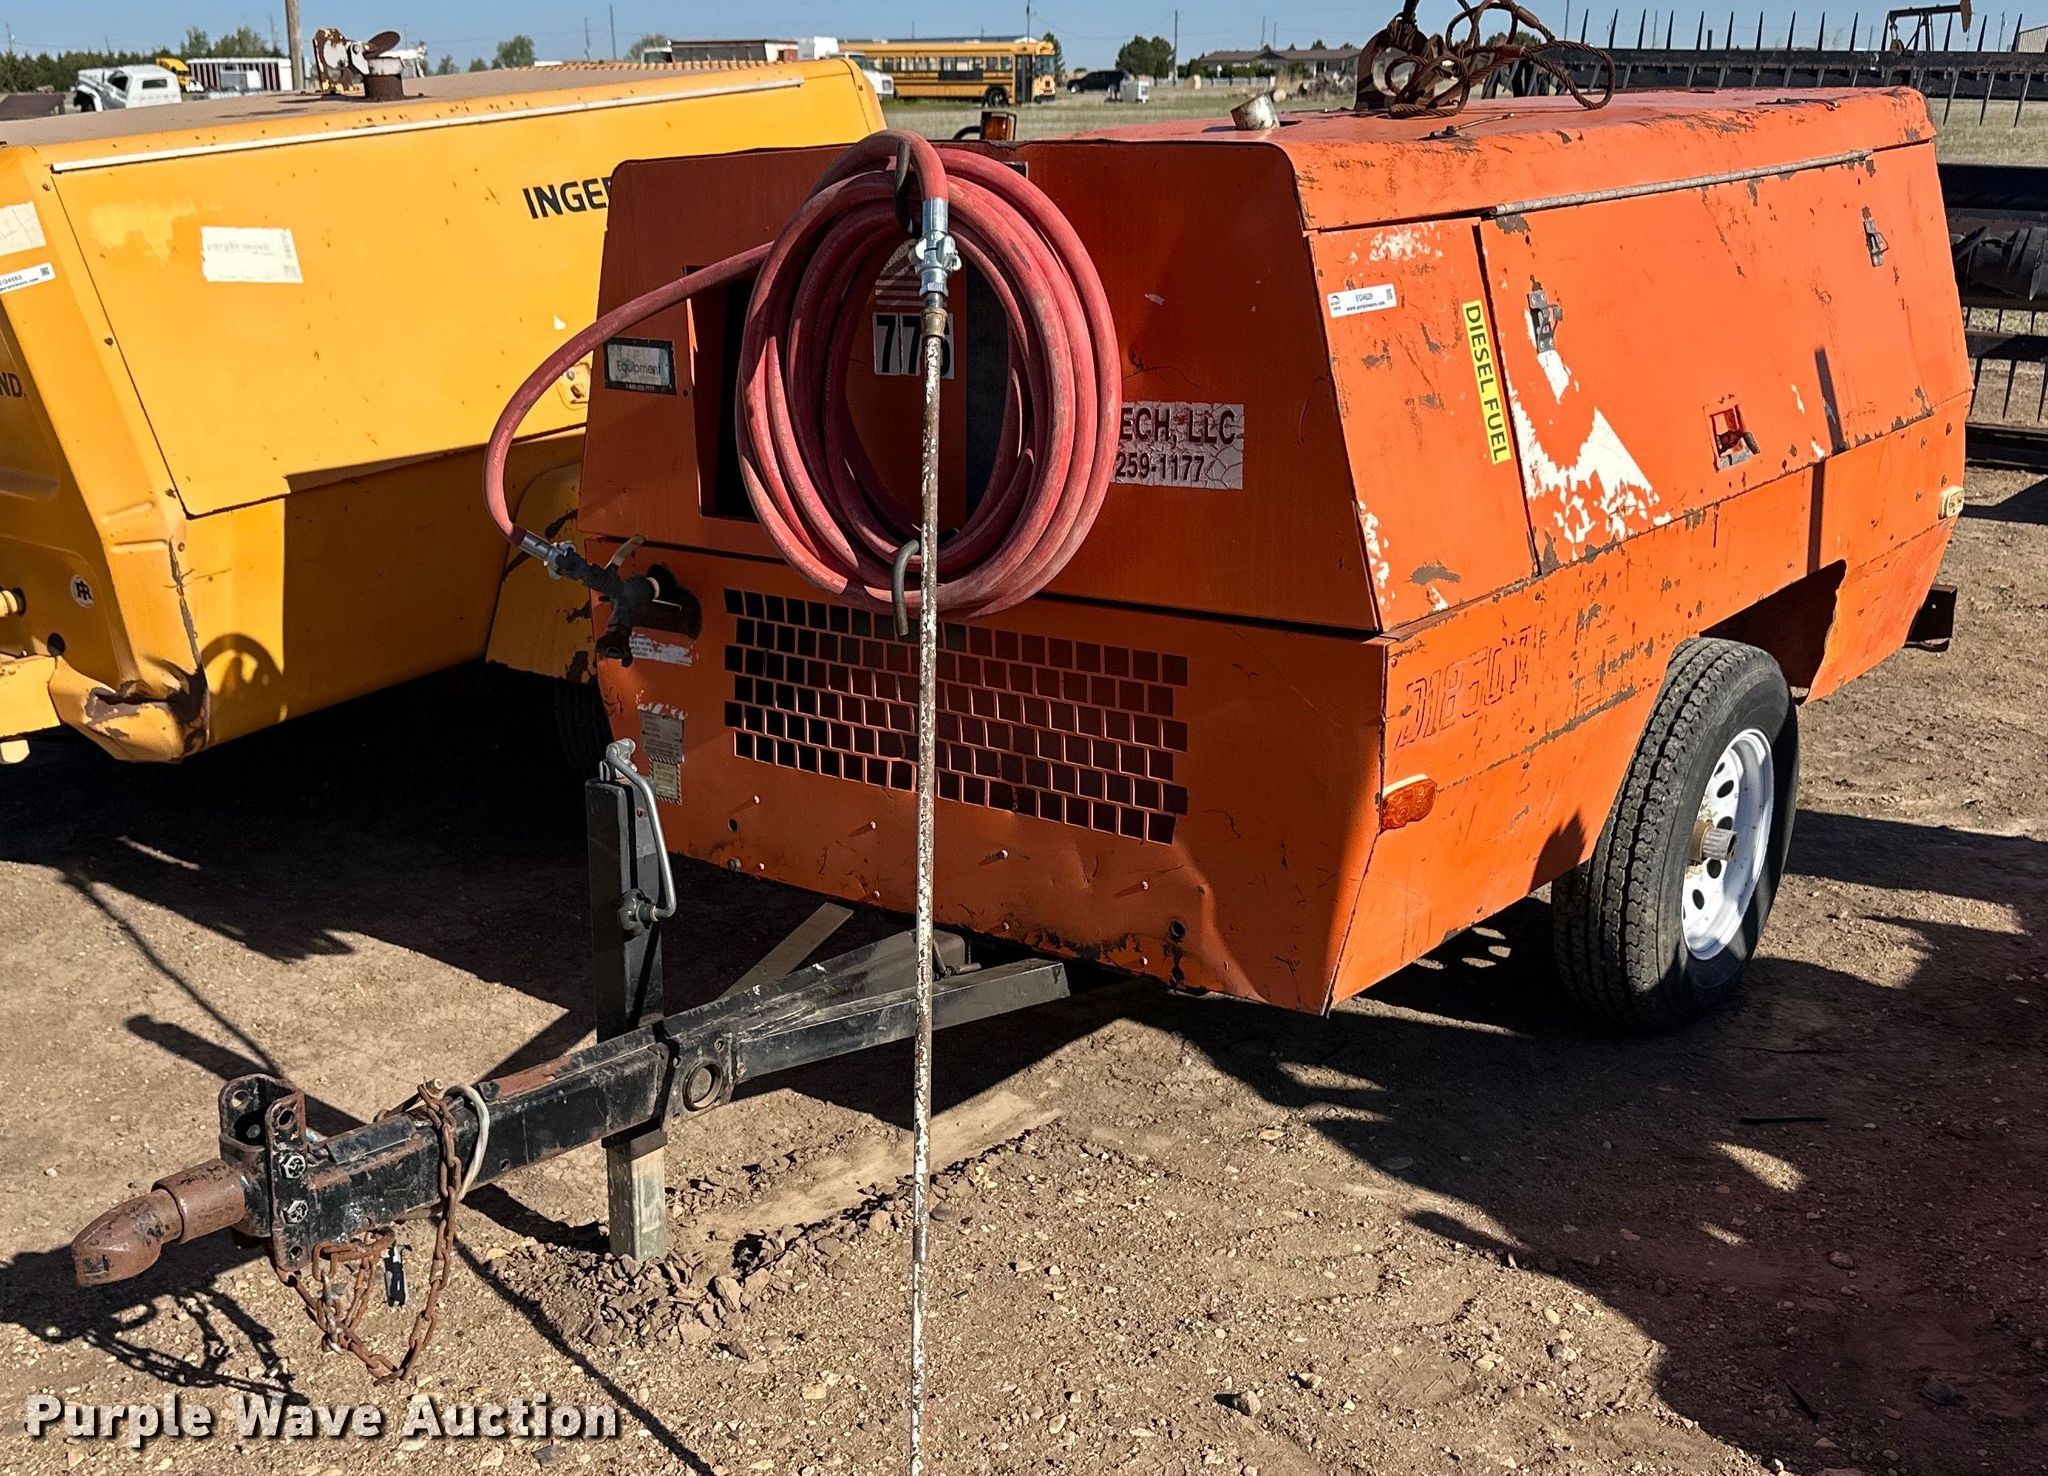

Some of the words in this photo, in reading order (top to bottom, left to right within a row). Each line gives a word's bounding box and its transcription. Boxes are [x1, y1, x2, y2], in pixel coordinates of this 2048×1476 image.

[1465, 305, 1494, 393] DIESEL
[1483, 397, 1508, 462] FUEL
[1188, 410, 1236, 444] LLC
[1115, 452, 1204, 481] 259-1177
